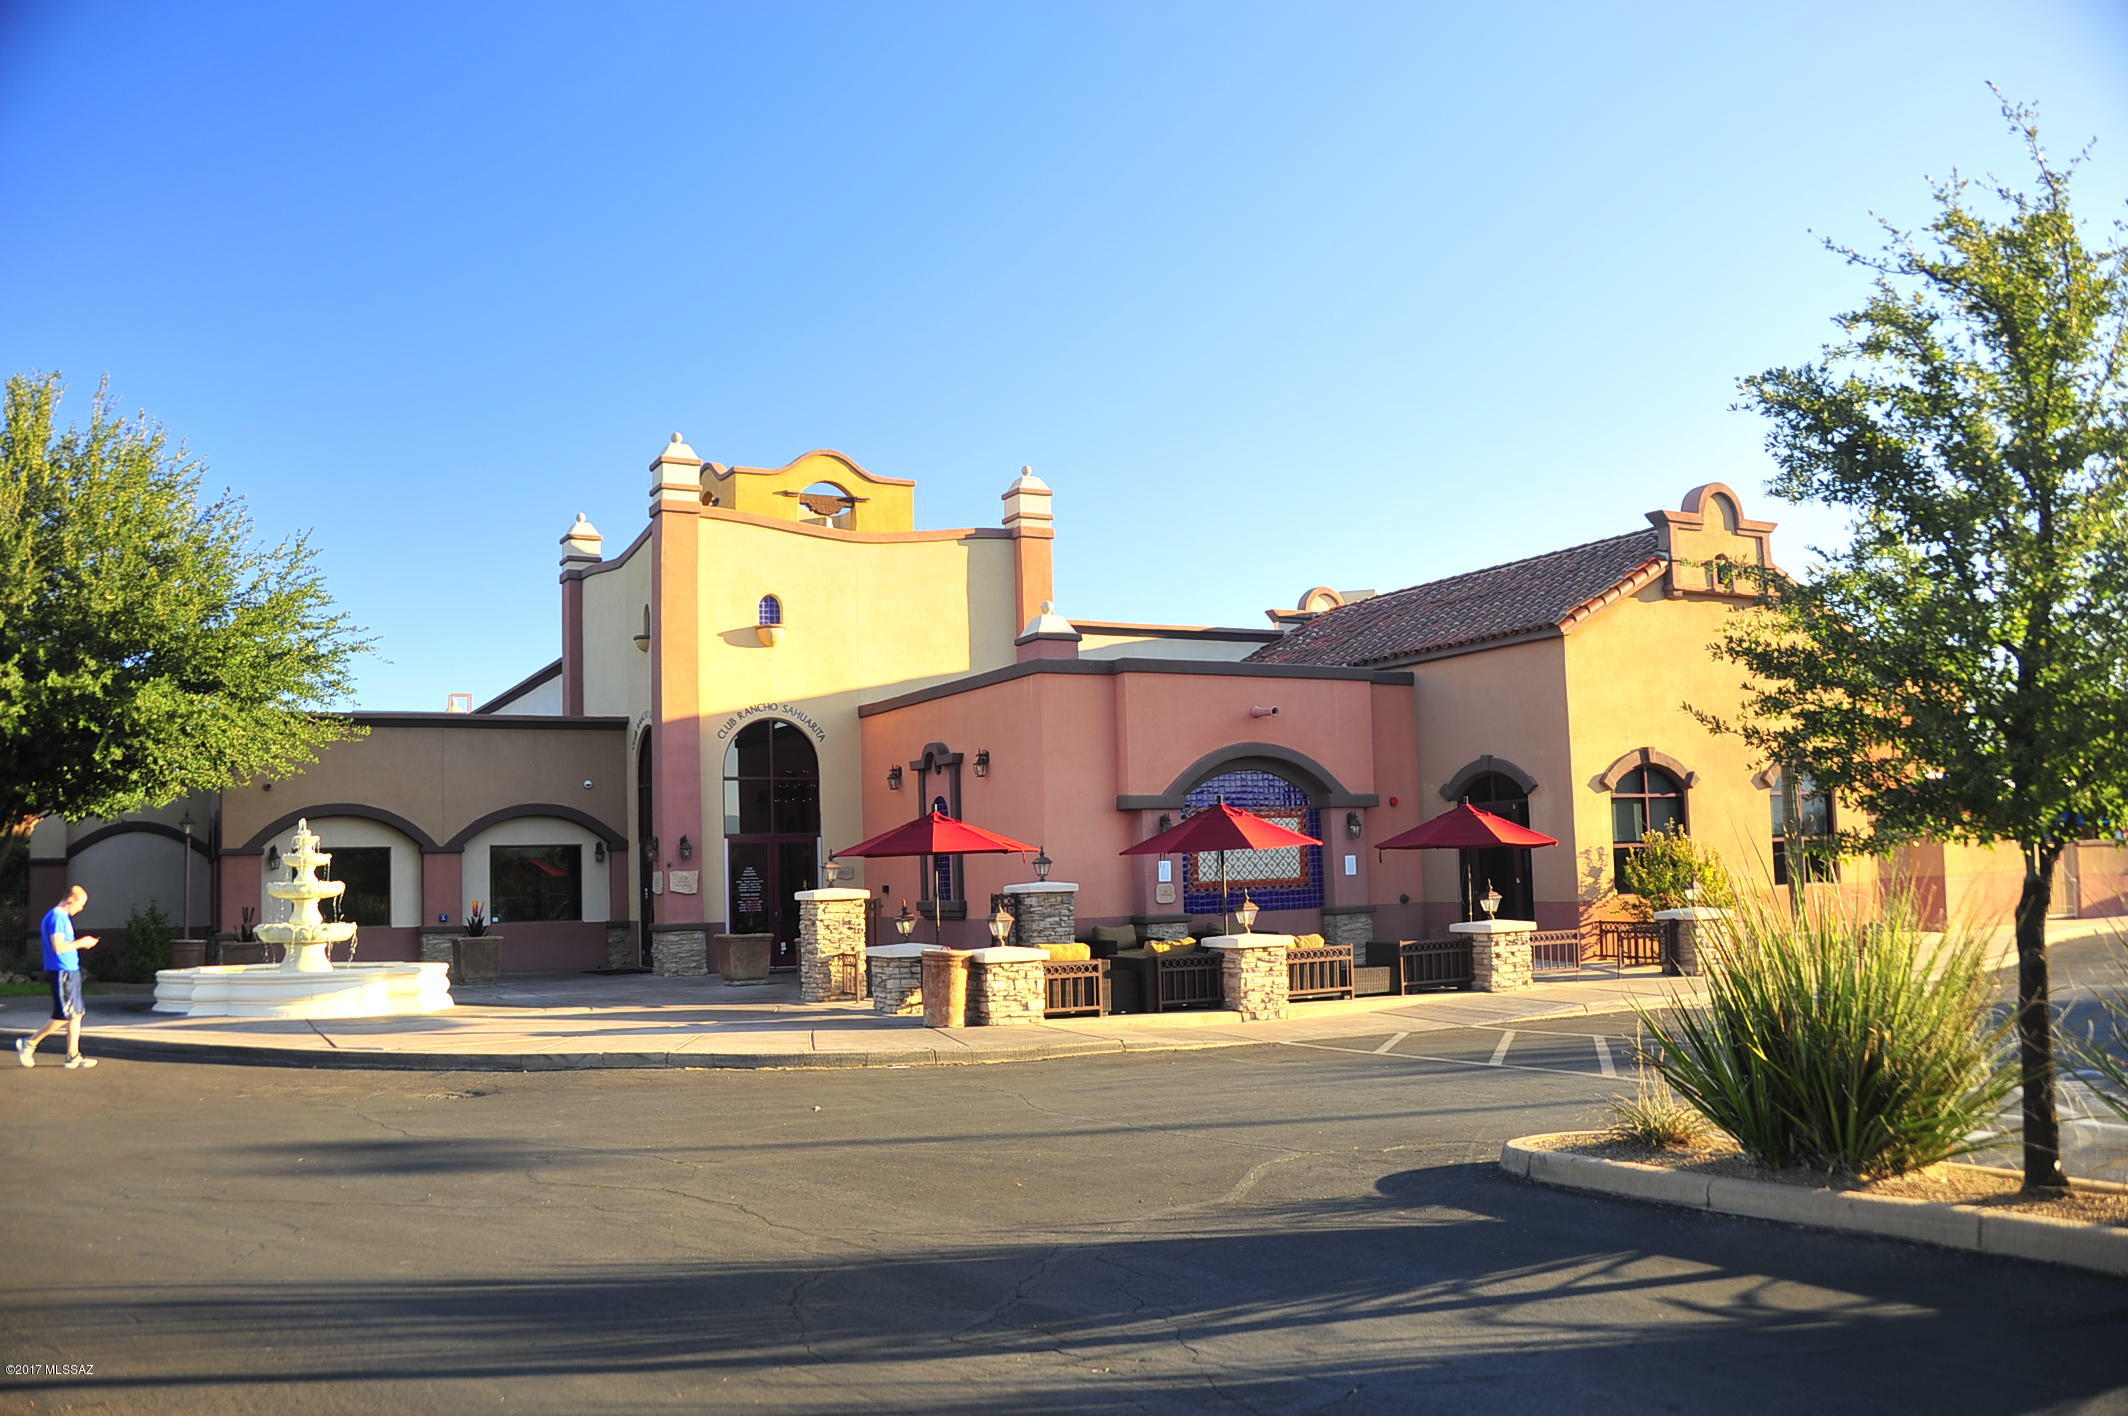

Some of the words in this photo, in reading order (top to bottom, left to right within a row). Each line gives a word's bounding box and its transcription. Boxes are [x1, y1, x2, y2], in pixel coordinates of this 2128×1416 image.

[717, 717, 737, 739] CLUB
[736, 702, 778, 720] RANCHO
[781, 704, 827, 743] SAHUARITA
